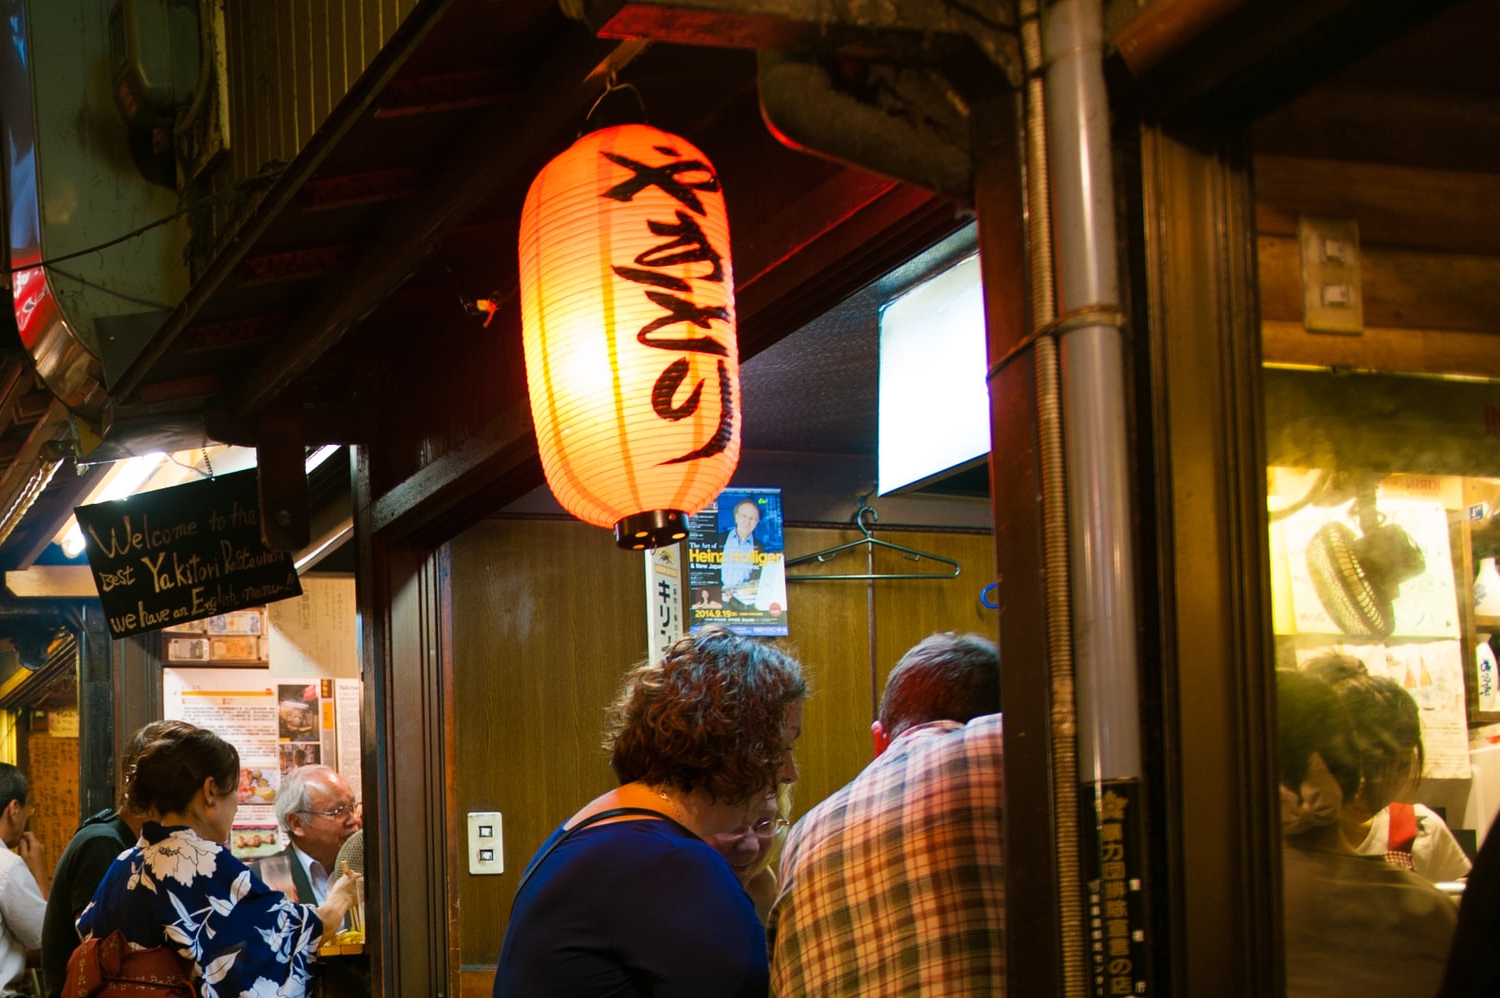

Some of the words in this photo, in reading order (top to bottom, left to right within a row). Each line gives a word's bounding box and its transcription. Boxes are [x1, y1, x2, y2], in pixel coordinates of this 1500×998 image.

[88, 513, 198, 559] Welcome
[208, 509, 228, 533] to
[230, 502, 258, 526] the
[139, 551, 221, 594] Yakitori
[689, 548, 725, 563] Heinz
[110, 614, 138, 634] we
[138, 600, 171, 629] have
[173, 606, 190, 620] an
[190, 586, 238, 615] English
